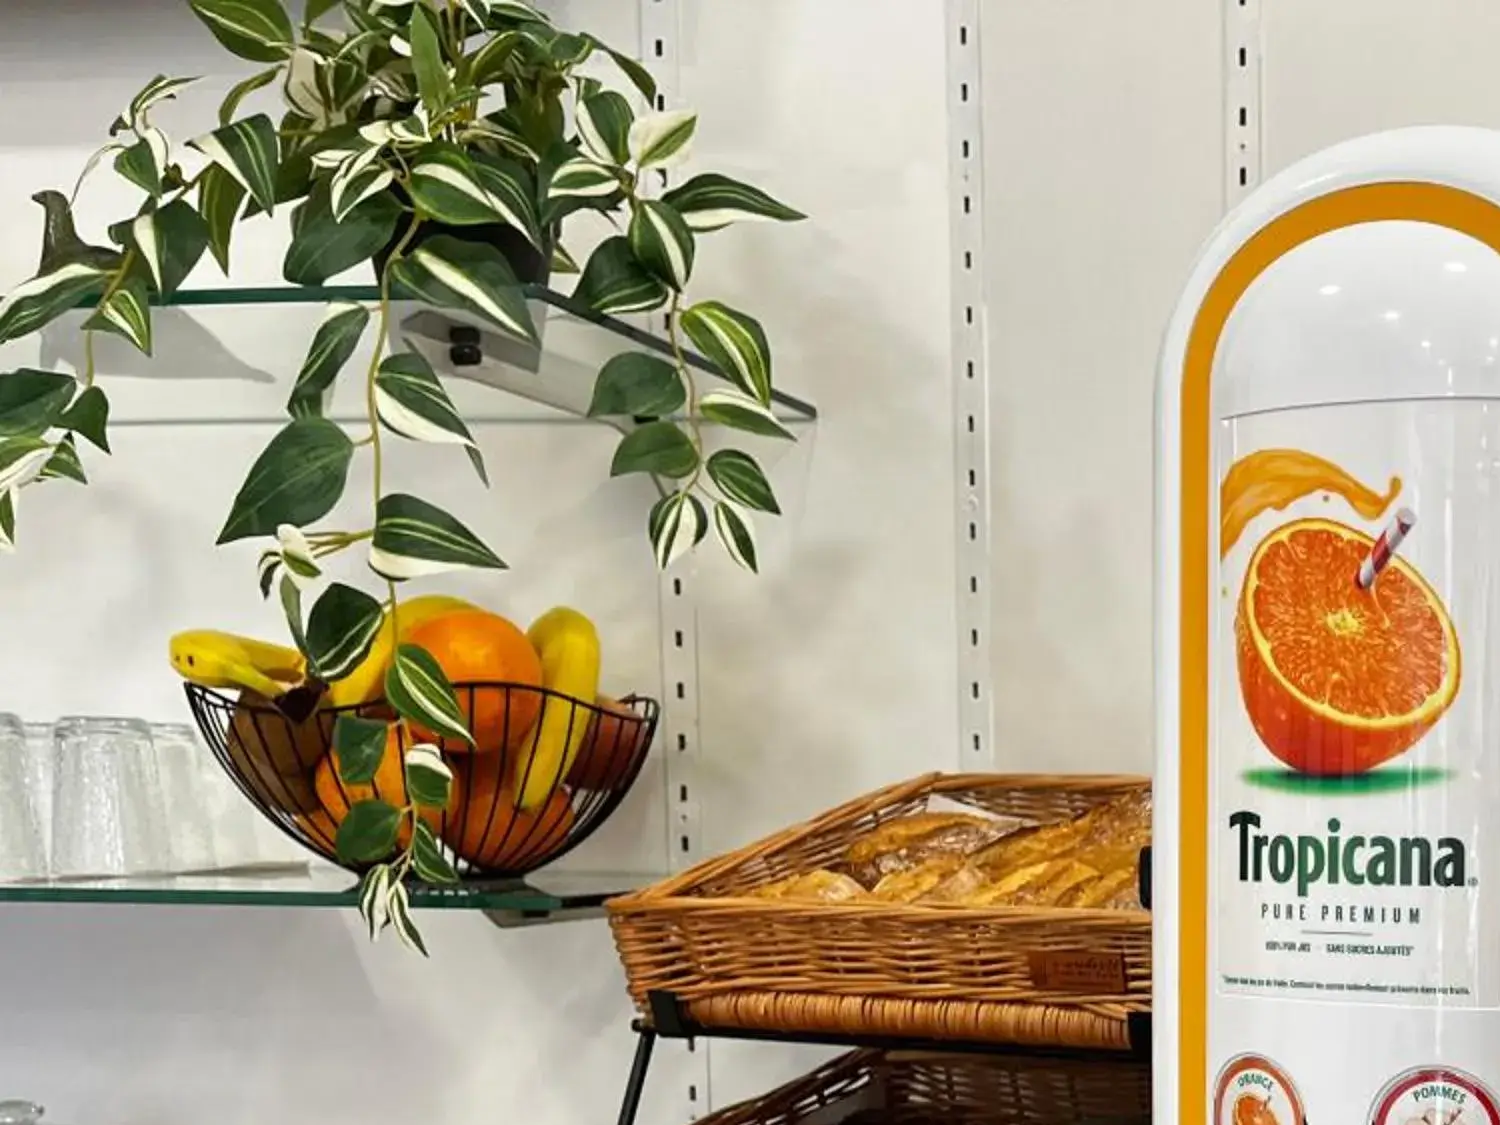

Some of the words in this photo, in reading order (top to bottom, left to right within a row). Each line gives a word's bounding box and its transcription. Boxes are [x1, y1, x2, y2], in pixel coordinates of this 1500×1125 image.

[1229, 810, 1466, 897] Tropicana
[1260, 902, 1307, 921] PURE
[1320, 905, 1422, 924] PREMIUM
[1237, 1073, 1274, 1091] ORANGE
[1412, 1085, 1467, 1105] POMMES
